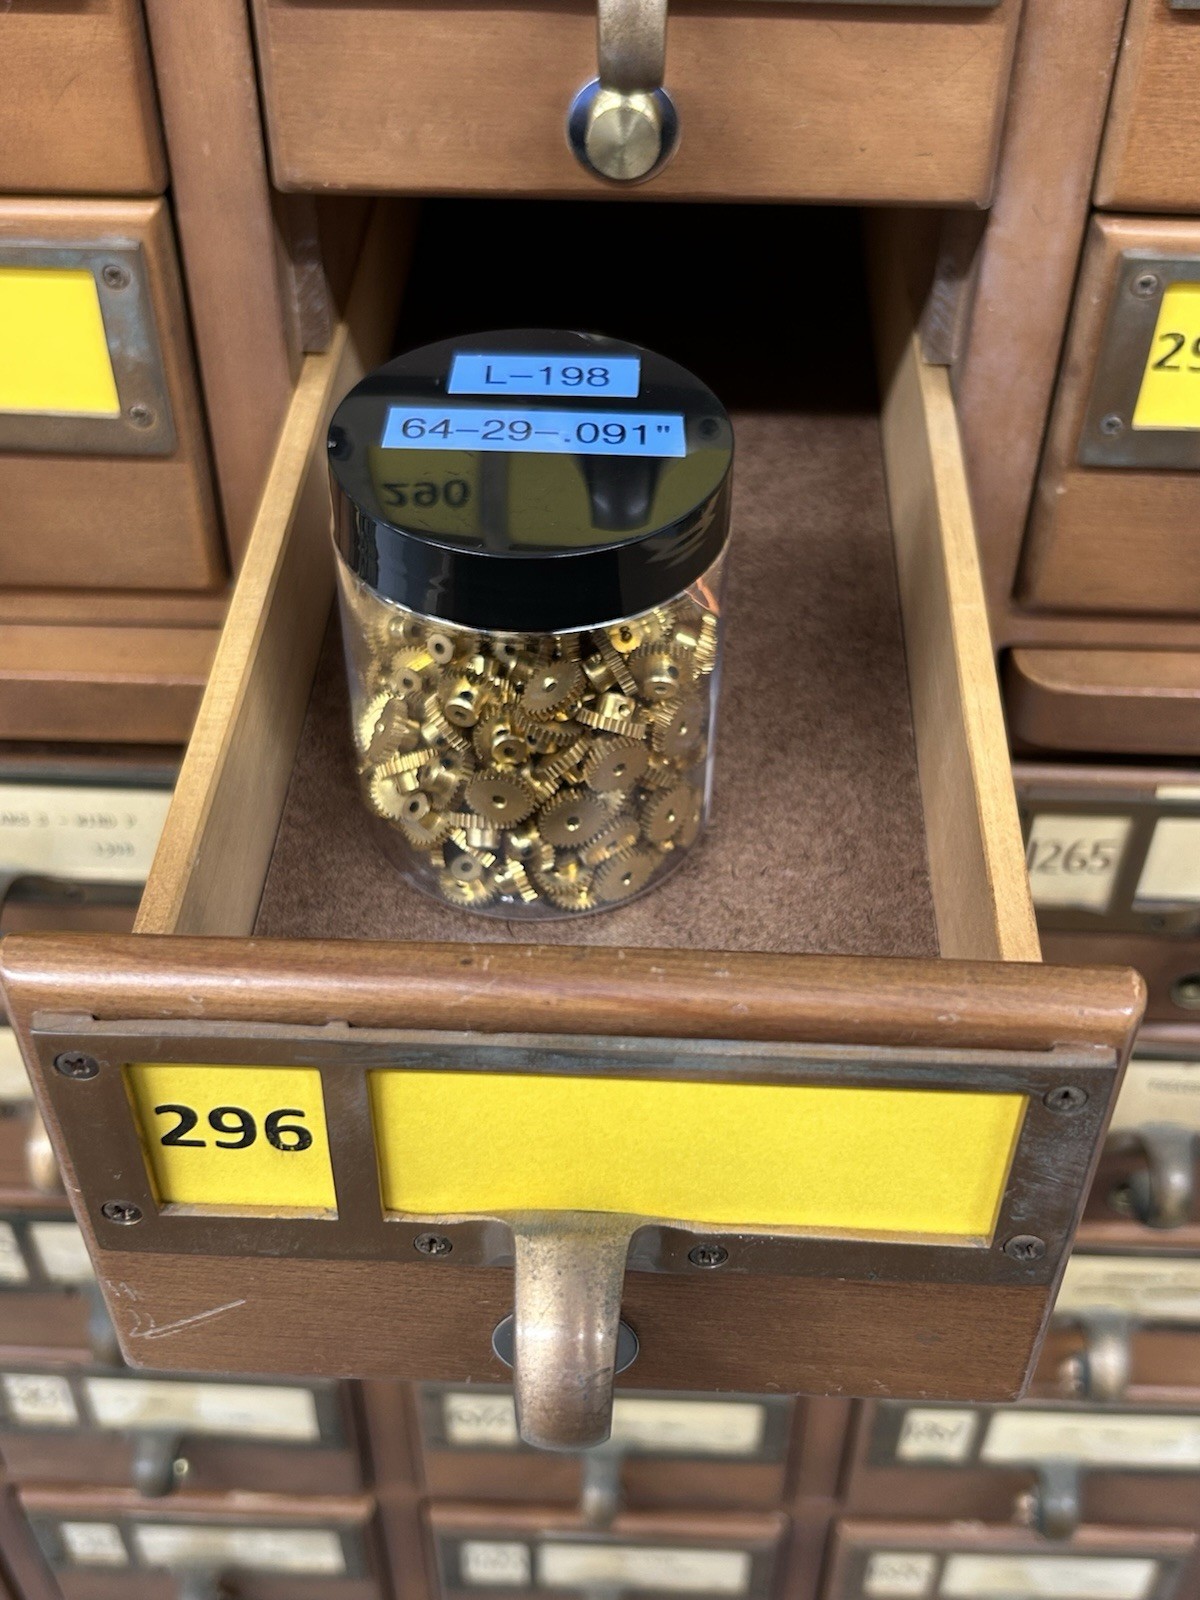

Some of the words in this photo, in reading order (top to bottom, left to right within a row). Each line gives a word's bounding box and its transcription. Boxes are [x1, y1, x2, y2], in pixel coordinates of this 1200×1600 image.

[484, 365, 610, 387] L-198
[401, 418, 671, 446] 64-29-.091"
[154, 1104, 313, 1152] 296
